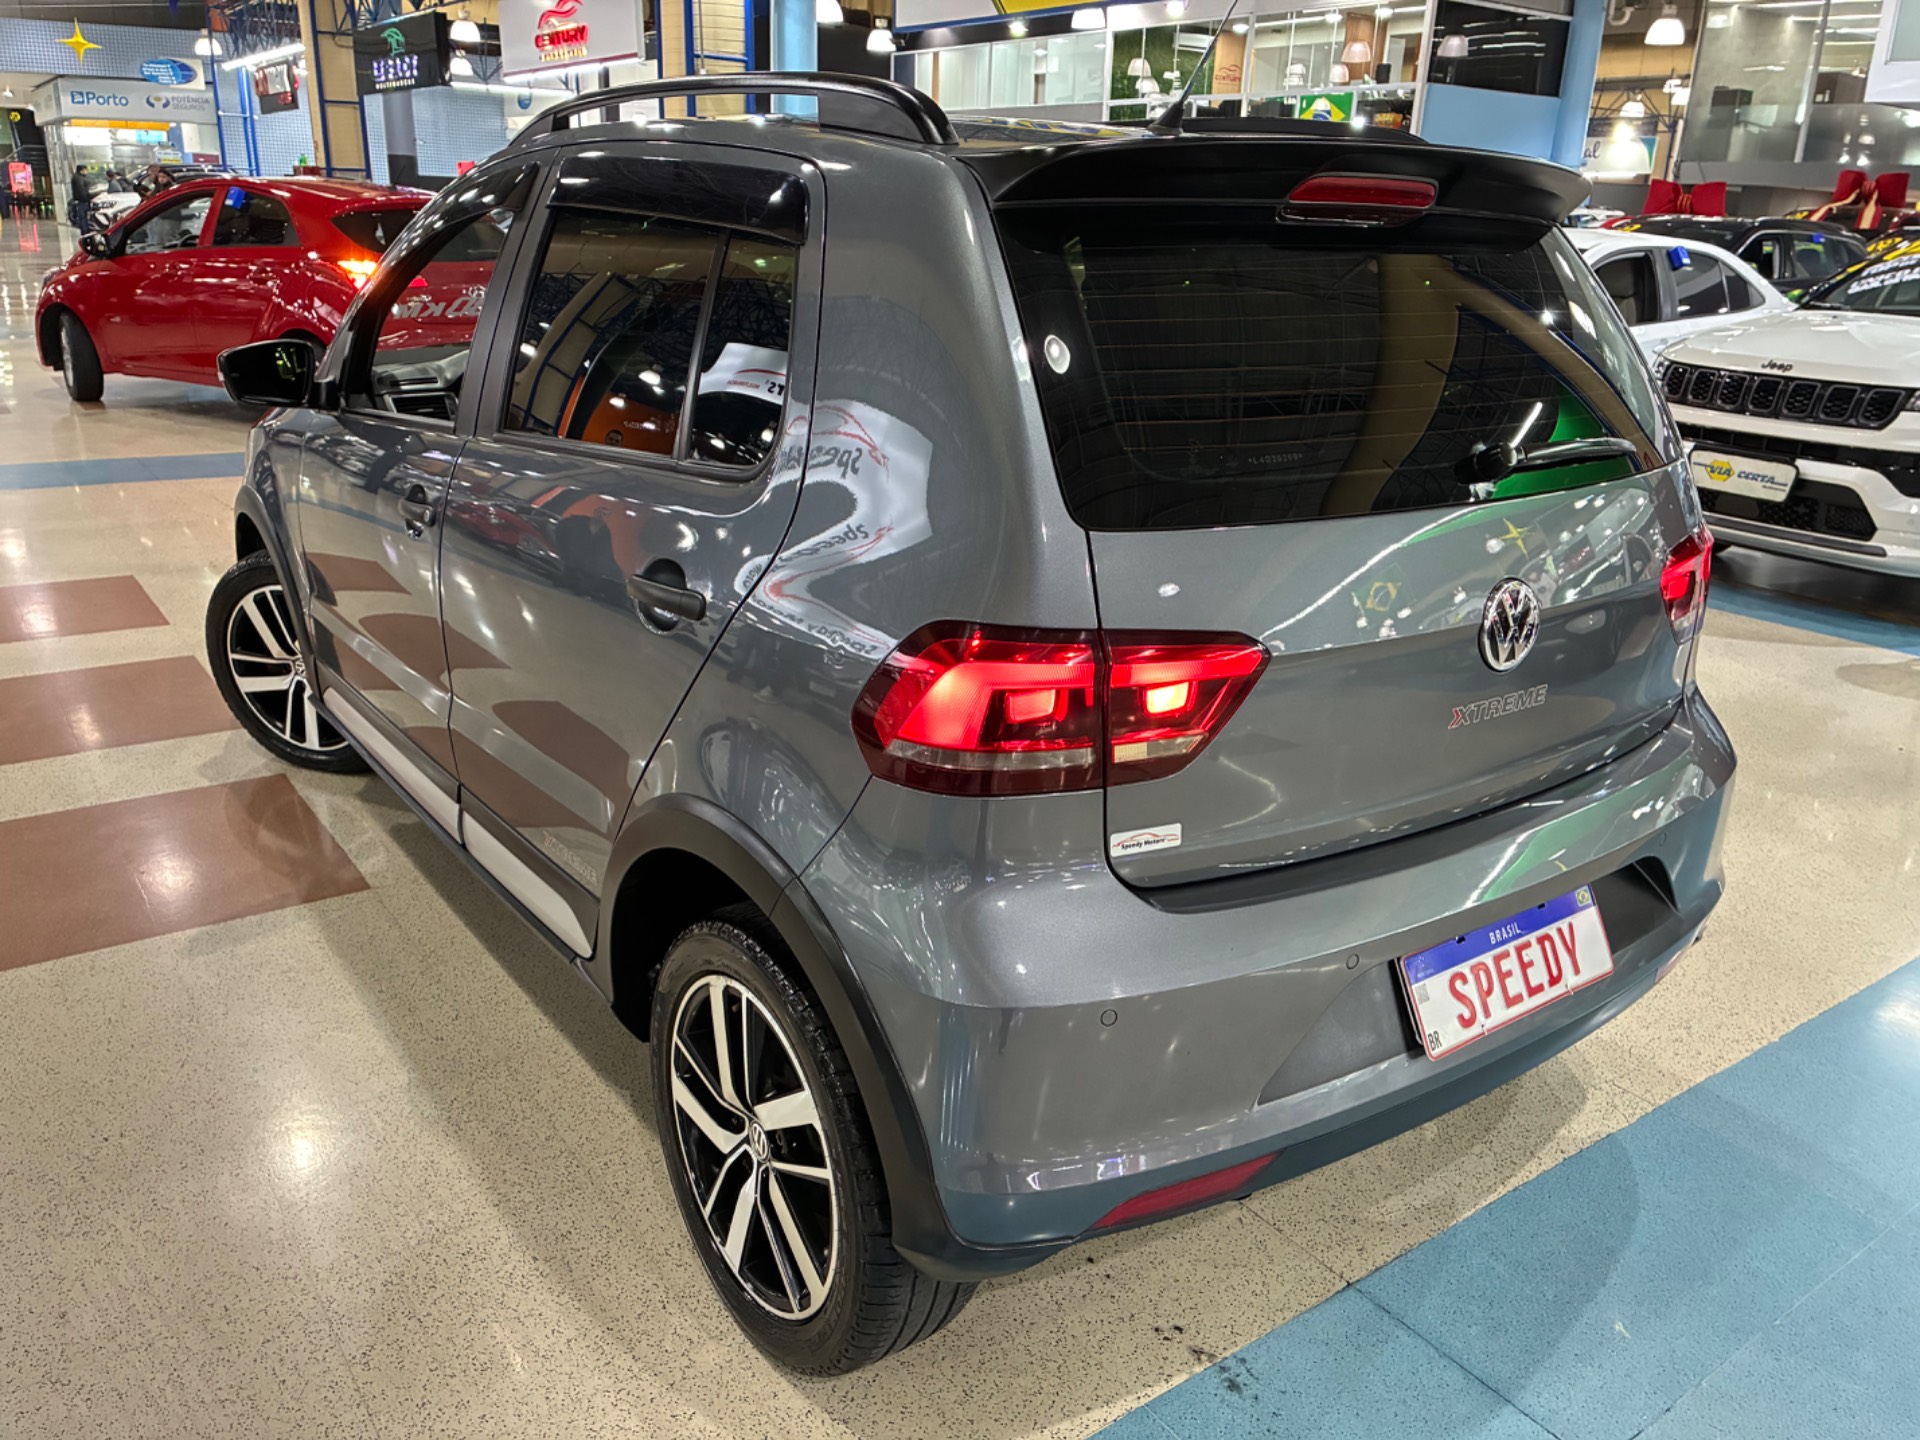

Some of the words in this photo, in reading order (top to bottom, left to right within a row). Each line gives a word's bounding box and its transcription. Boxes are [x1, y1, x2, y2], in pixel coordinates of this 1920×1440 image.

[86, 91, 129, 107] Porto
[1760, 359, 1793, 373] Jeep
[1710, 465, 1732, 477] VIA
[1737, 470, 1776, 483] CERTA
[1447, 683, 1549, 730] XTREME
[1120, 841, 1144, 851] Speedy
[1489, 921, 1522, 945] BRASIL
[1448, 921, 1581, 1030] SPEEDY
[1427, 1030, 1443, 1052] BR
